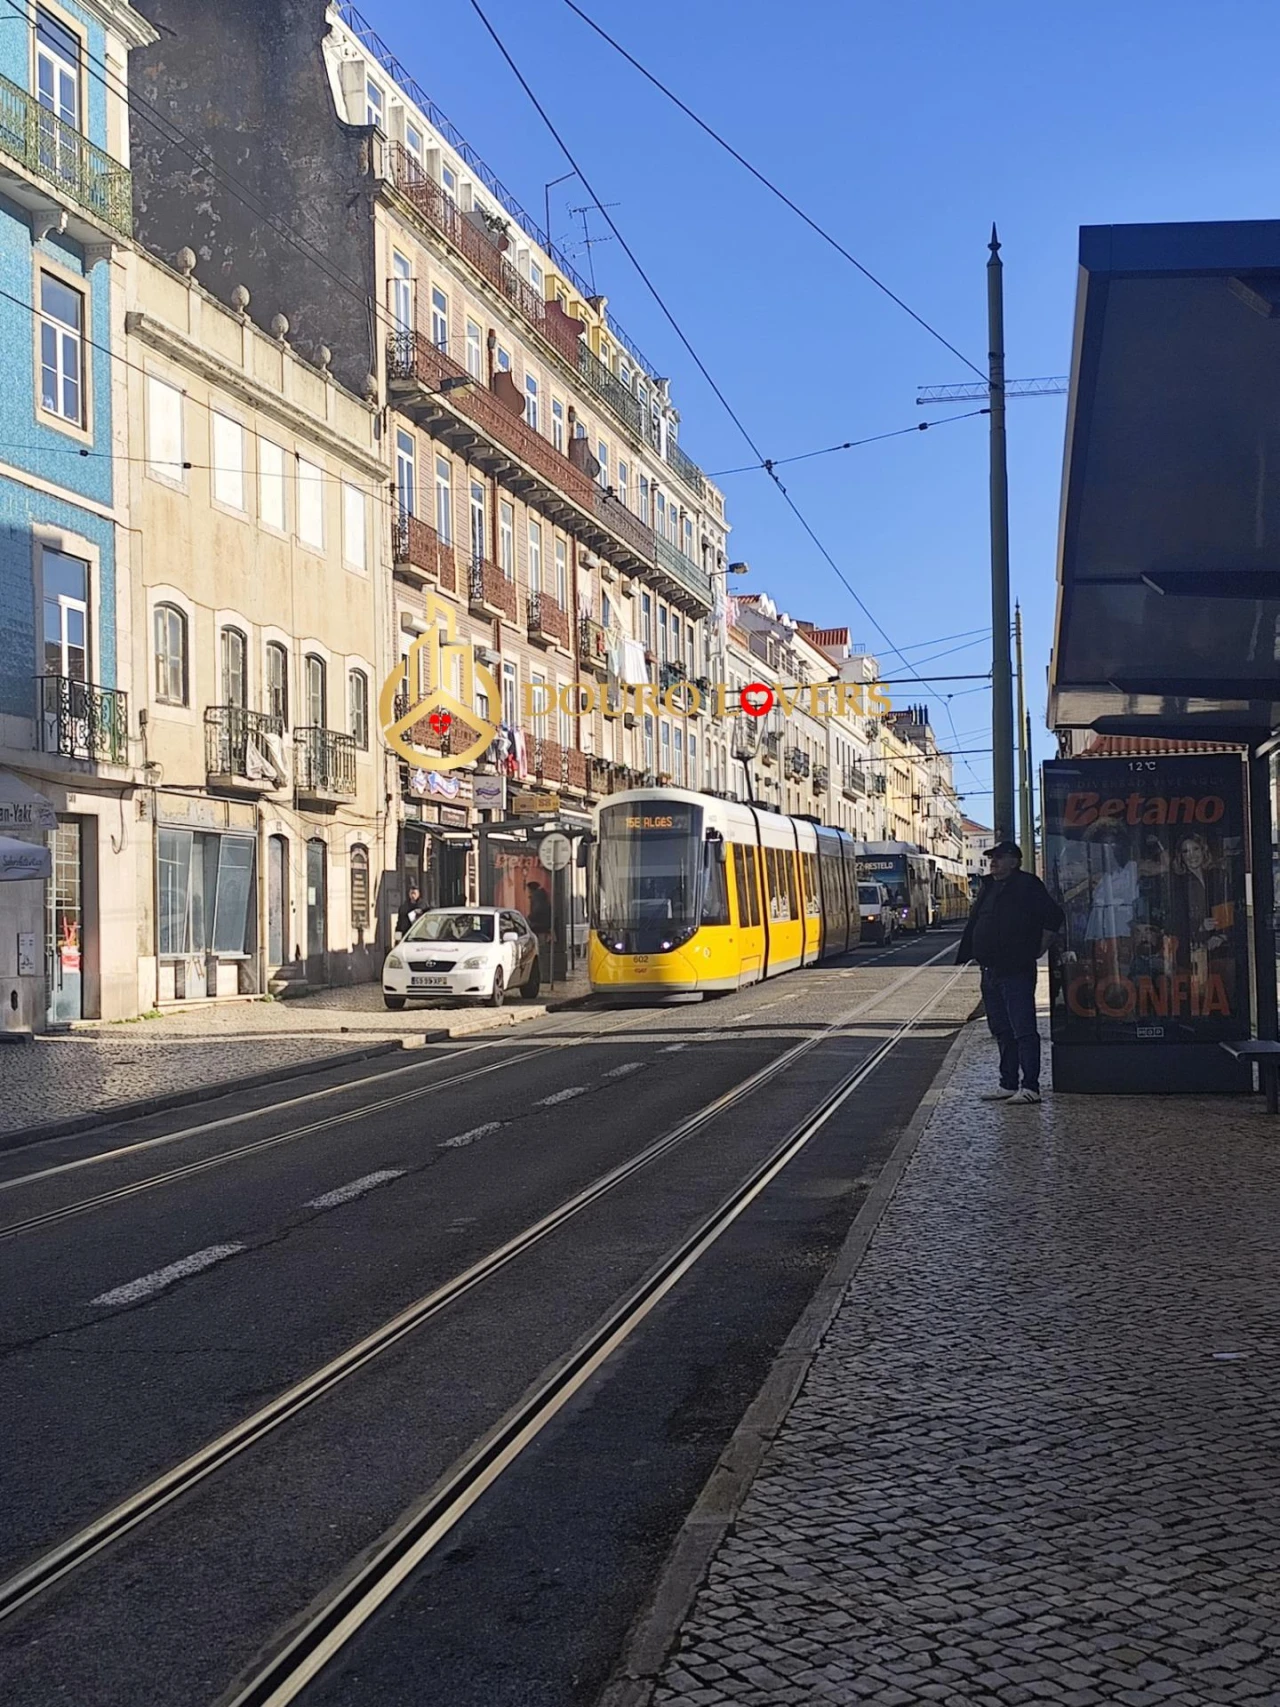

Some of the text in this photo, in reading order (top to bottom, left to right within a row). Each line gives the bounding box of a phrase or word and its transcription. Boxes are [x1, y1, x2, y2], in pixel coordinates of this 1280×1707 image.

[1063, 792, 1225, 827] Betano
[633, 955, 649, 964] 602
[1067, 974, 1231, 1017] CONFIA
